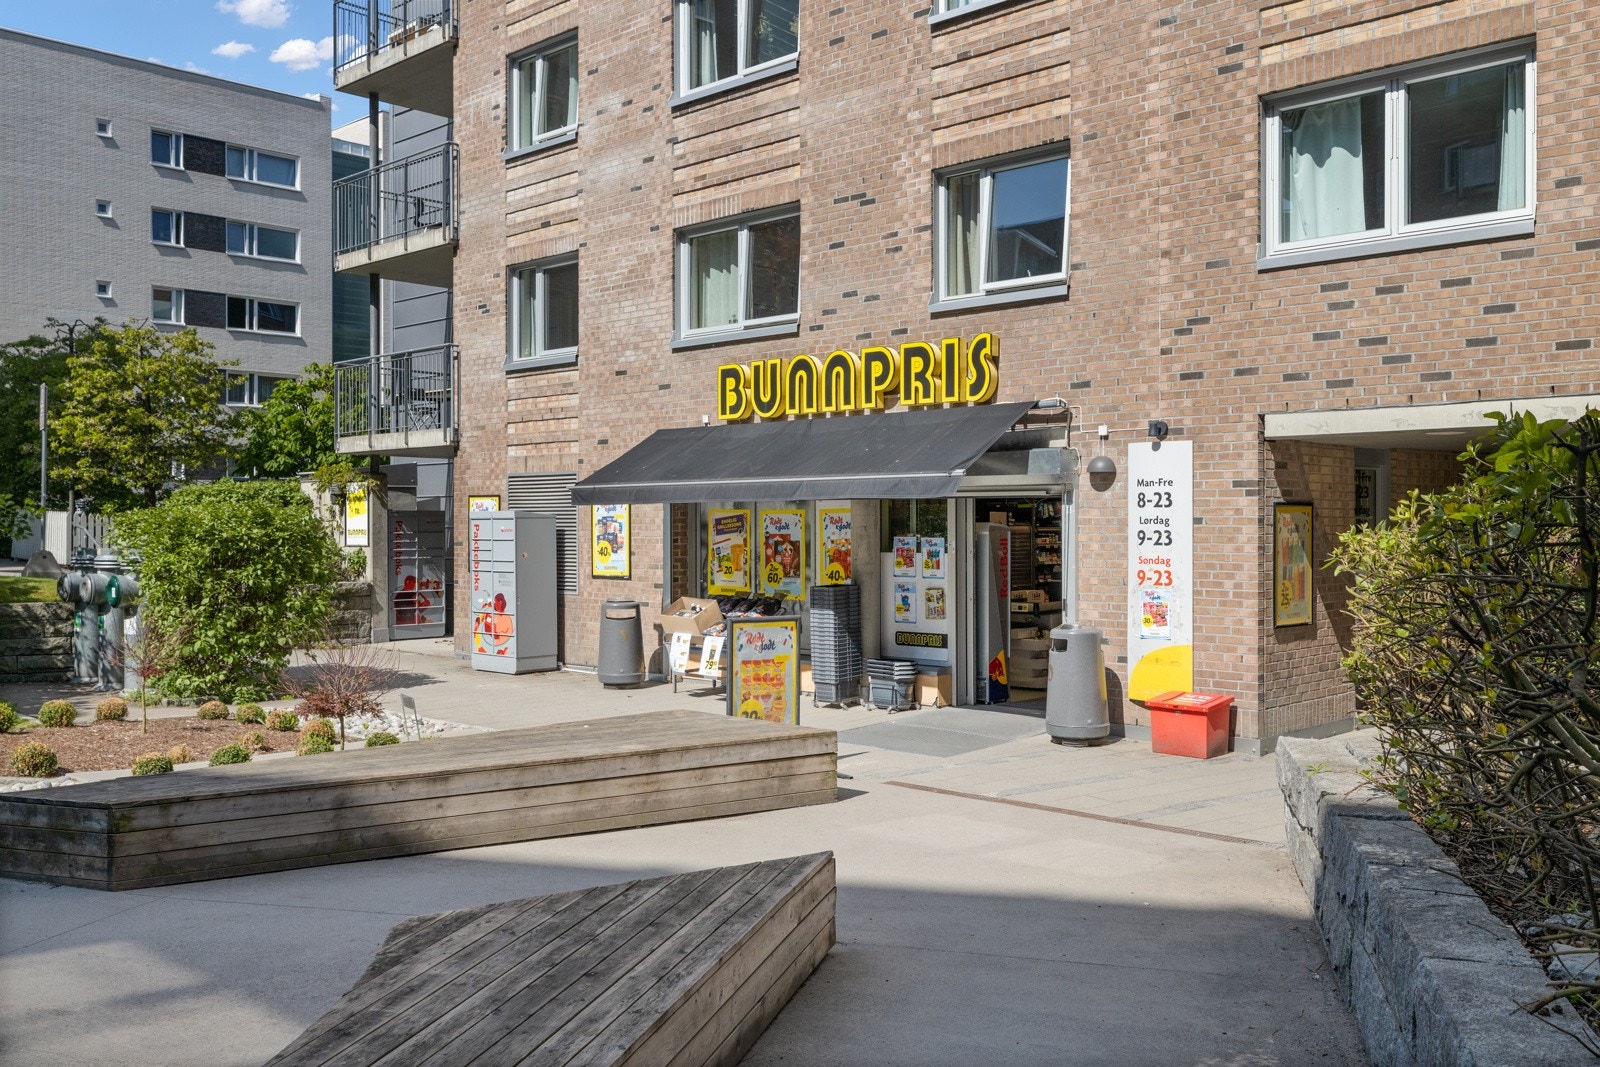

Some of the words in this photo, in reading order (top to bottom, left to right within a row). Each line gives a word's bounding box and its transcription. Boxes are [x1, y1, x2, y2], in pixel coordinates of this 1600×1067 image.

[717, 332, 998, 420] BUNNPRIS
[1136, 478, 1174, 488] Man-Fre
[1137, 491, 1173, 509] 8-23
[1139, 515, 1170, 528] Lørdag
[1137, 529, 1173, 546] 9-23
[999, 537, 1008, 567] Bull
[1138, 556, 1171, 568] Søndag
[999, 568, 1008, 598] Red
[1137, 569, 1173, 587] 9-23
